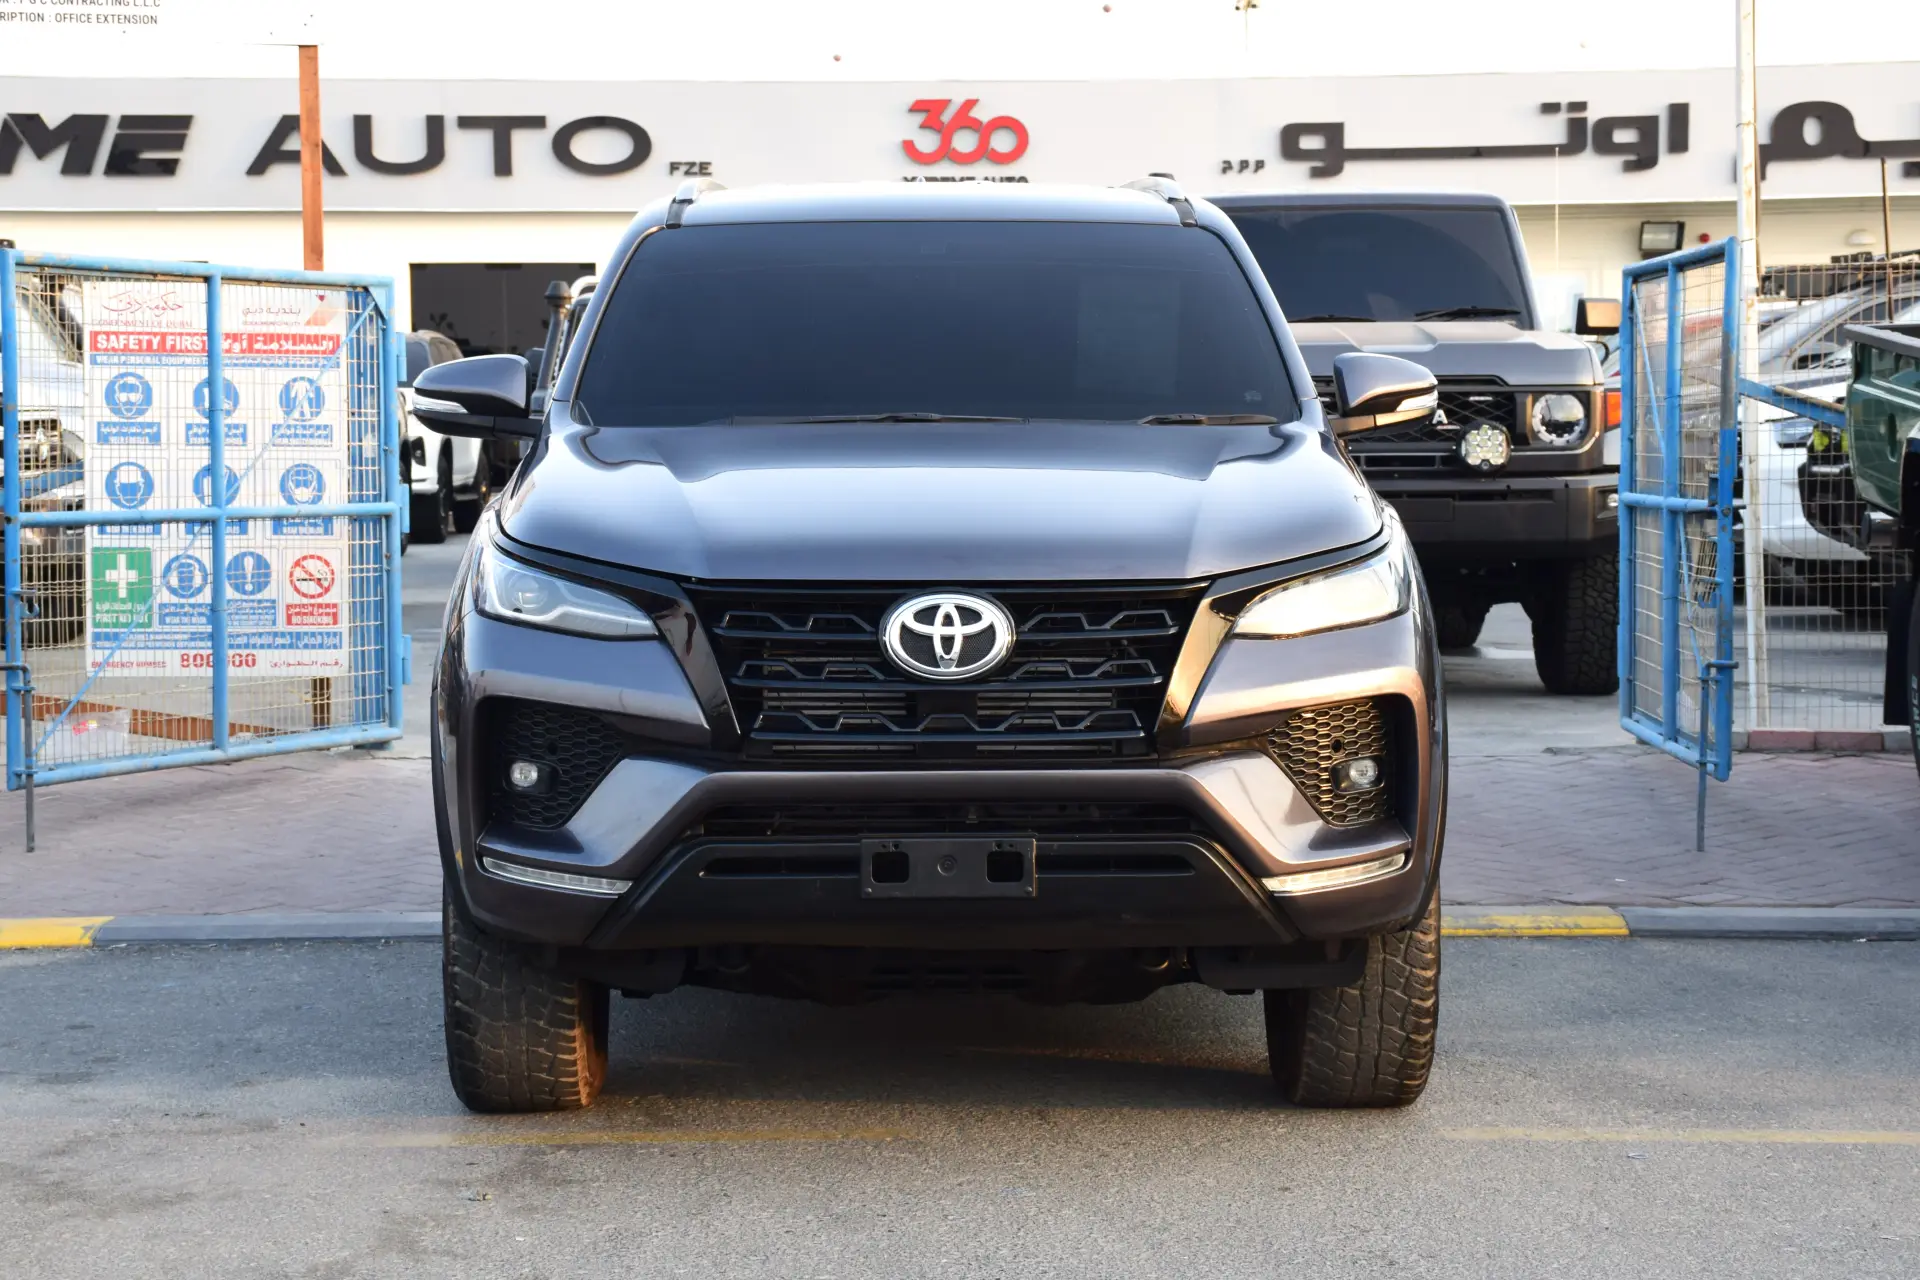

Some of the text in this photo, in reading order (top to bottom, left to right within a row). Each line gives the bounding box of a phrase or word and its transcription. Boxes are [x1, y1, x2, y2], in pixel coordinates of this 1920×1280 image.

[54, 13, 93, 24] OFFICE
[96, 14, 158, 25] EXTENSION
[902, 98, 1030, 166] 360
[245, 113, 652, 177] AUTO
[669, 161, 712, 177] FZE
[96, 334, 161, 350] SAFETY
[95, 355, 119, 364] WEAR
[291, 615, 334, 625] NO SMOKING
[180, 652, 257, 669] 80000
